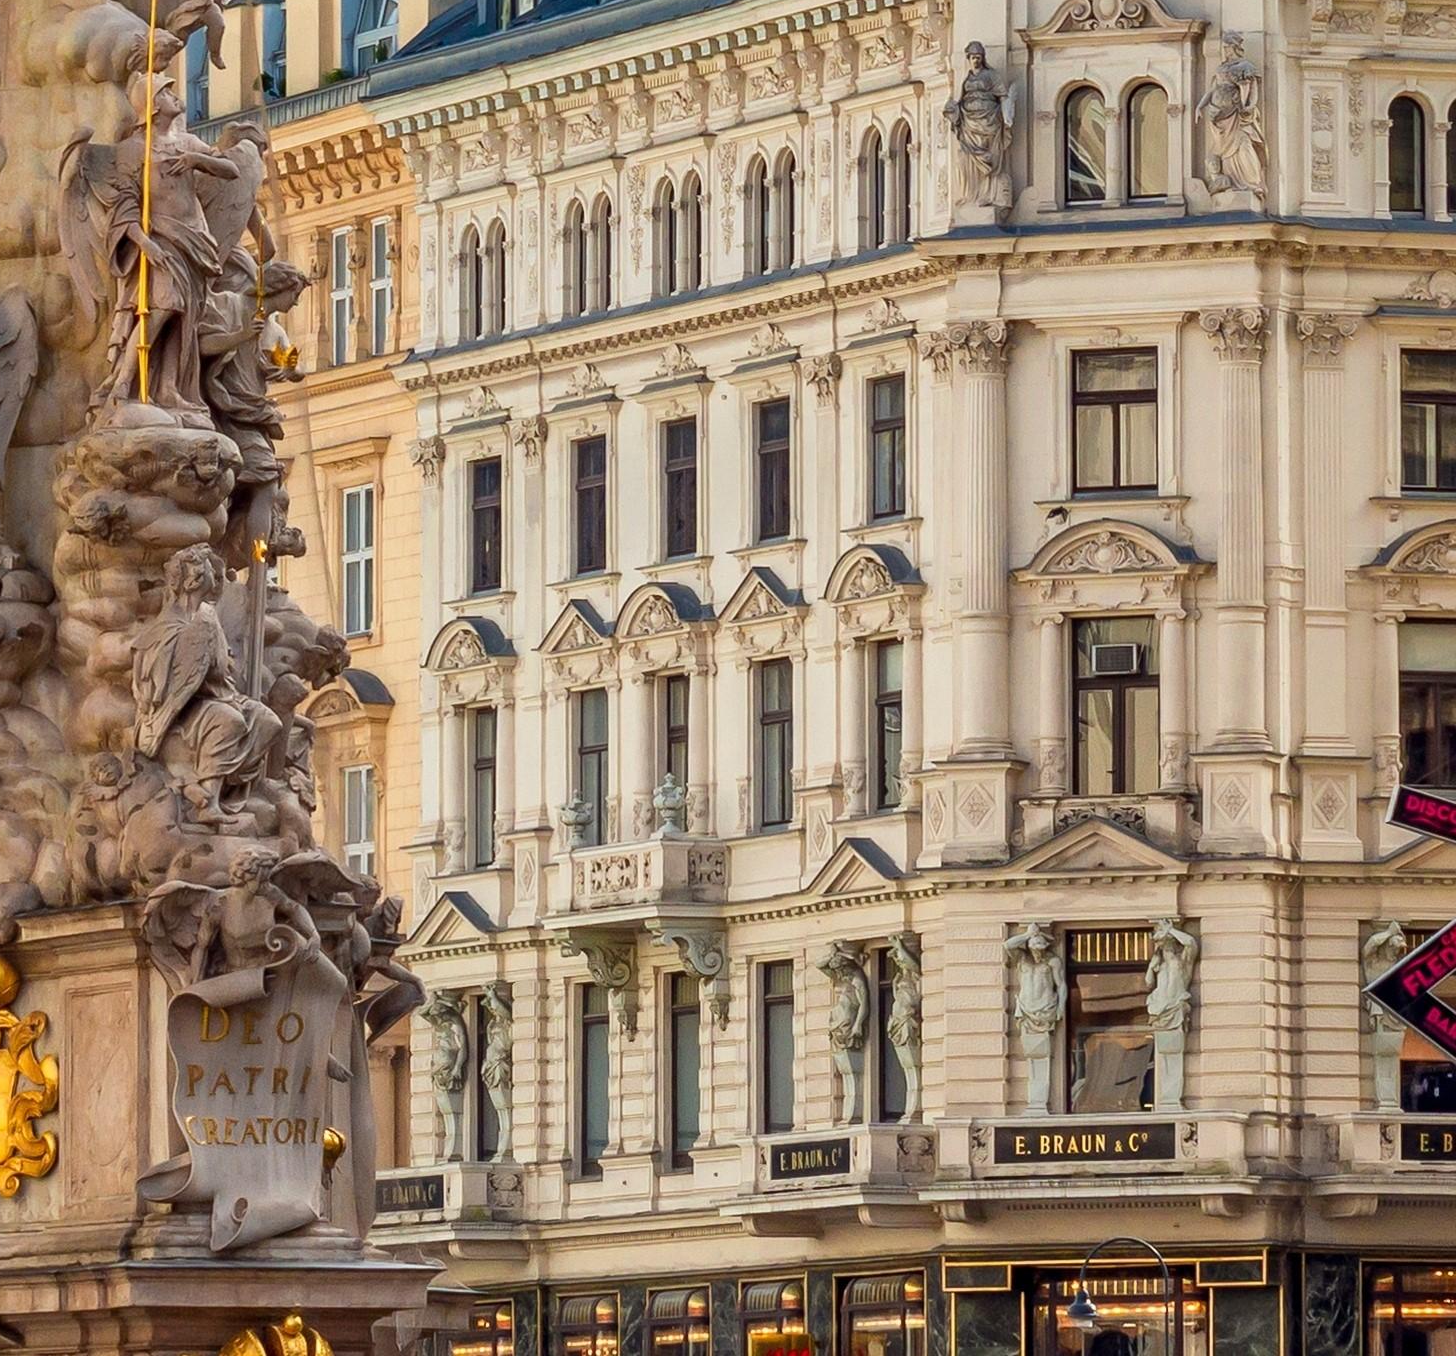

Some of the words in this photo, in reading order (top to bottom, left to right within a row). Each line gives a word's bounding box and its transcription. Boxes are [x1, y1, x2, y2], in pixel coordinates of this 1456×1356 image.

[200, 1005, 304, 1044] DEO
[186, 1064, 312, 1097] PATRI
[185, 1116, 320, 1146] CREATORI
[1420, 1133, 1435, 1152] E.
[1015, 1136, 1031, 1155] E.
[1040, 1134, 1106, 1155] BRAUN
[1114, 1140, 1123, 1153] &
[791, 1148, 822, 1170] BRAUN
